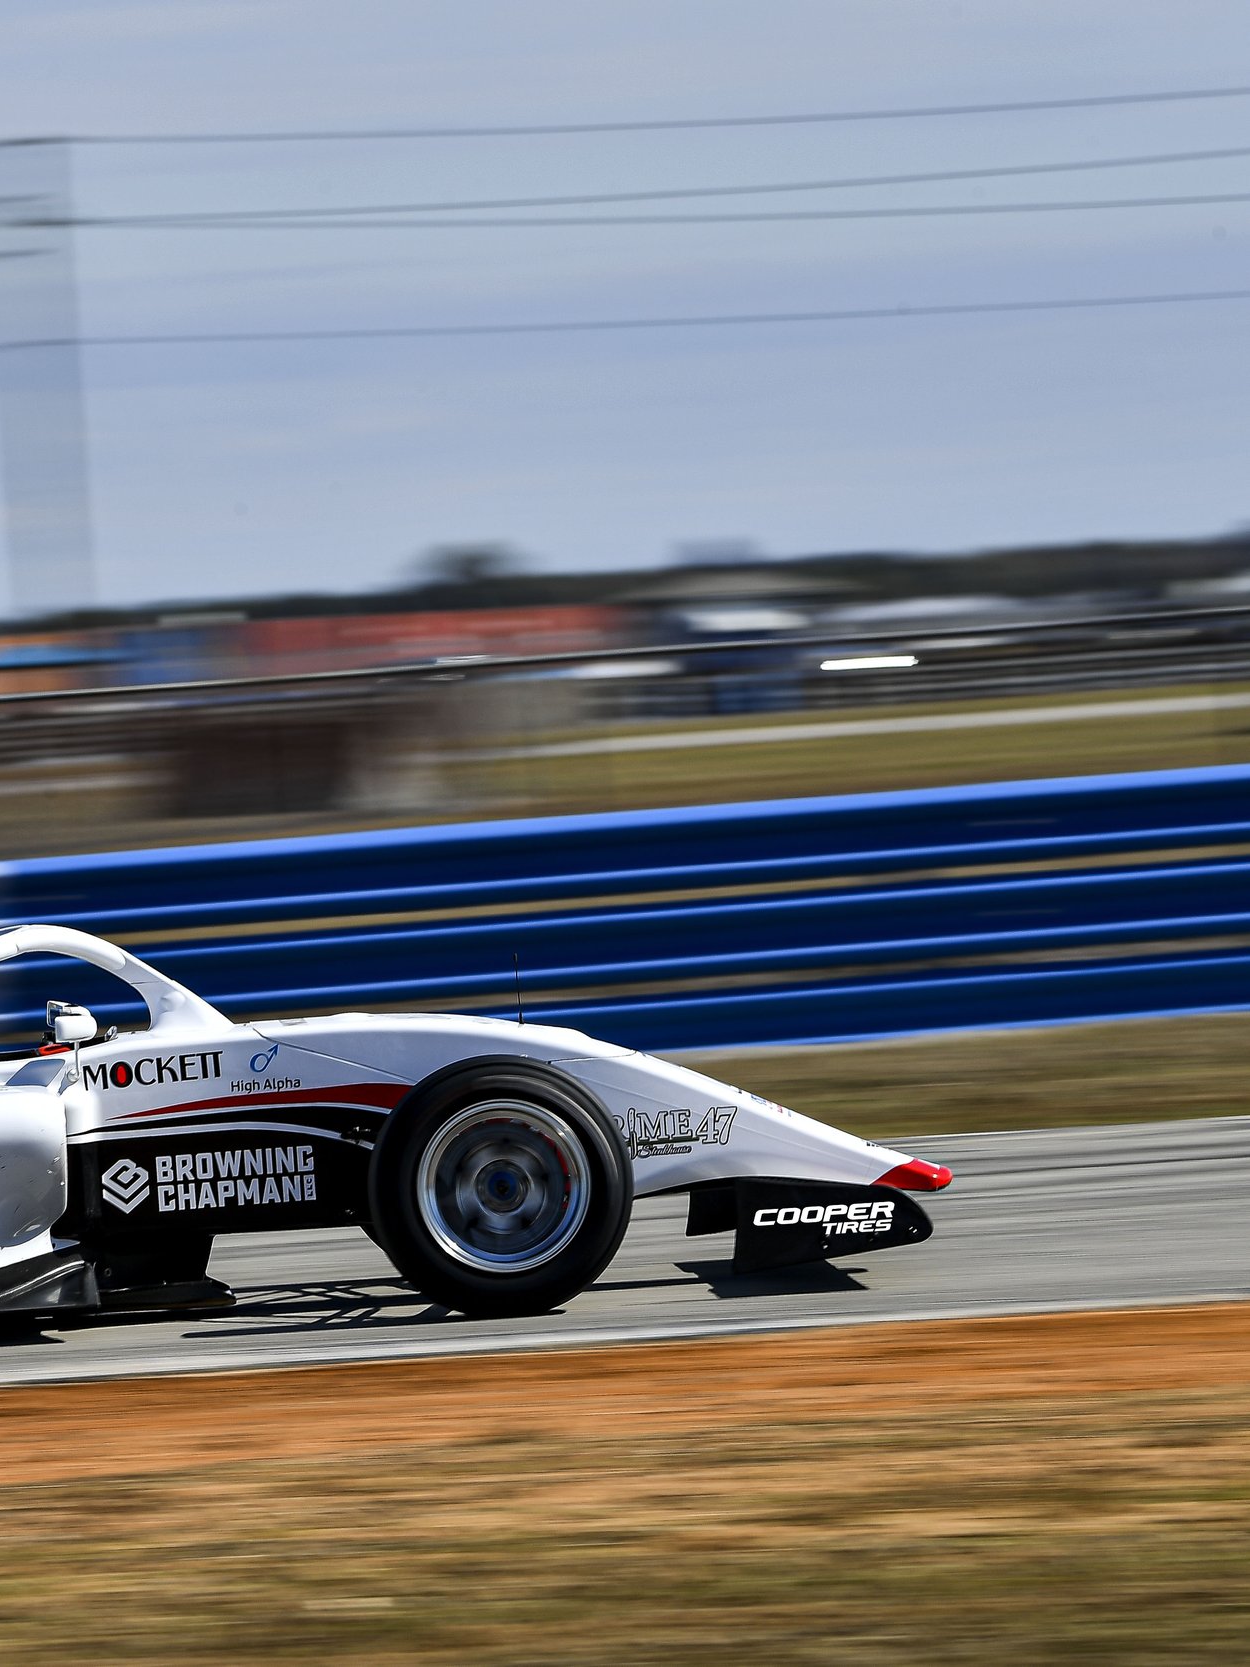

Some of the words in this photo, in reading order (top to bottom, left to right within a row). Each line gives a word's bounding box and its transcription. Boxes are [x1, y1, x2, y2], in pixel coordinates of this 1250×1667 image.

[82, 1050, 224, 1091] MOCKETT
[231, 1079, 260, 1094] High
[263, 1077, 301, 1093] Alpha
[695, 1105, 738, 1146] 47
[155, 1145, 315, 1183] BROWNING
[157, 1175, 302, 1213] CHAPMAN
[753, 1201, 896, 1227] COOPER
[822, 1218, 893, 1235] TIRES
